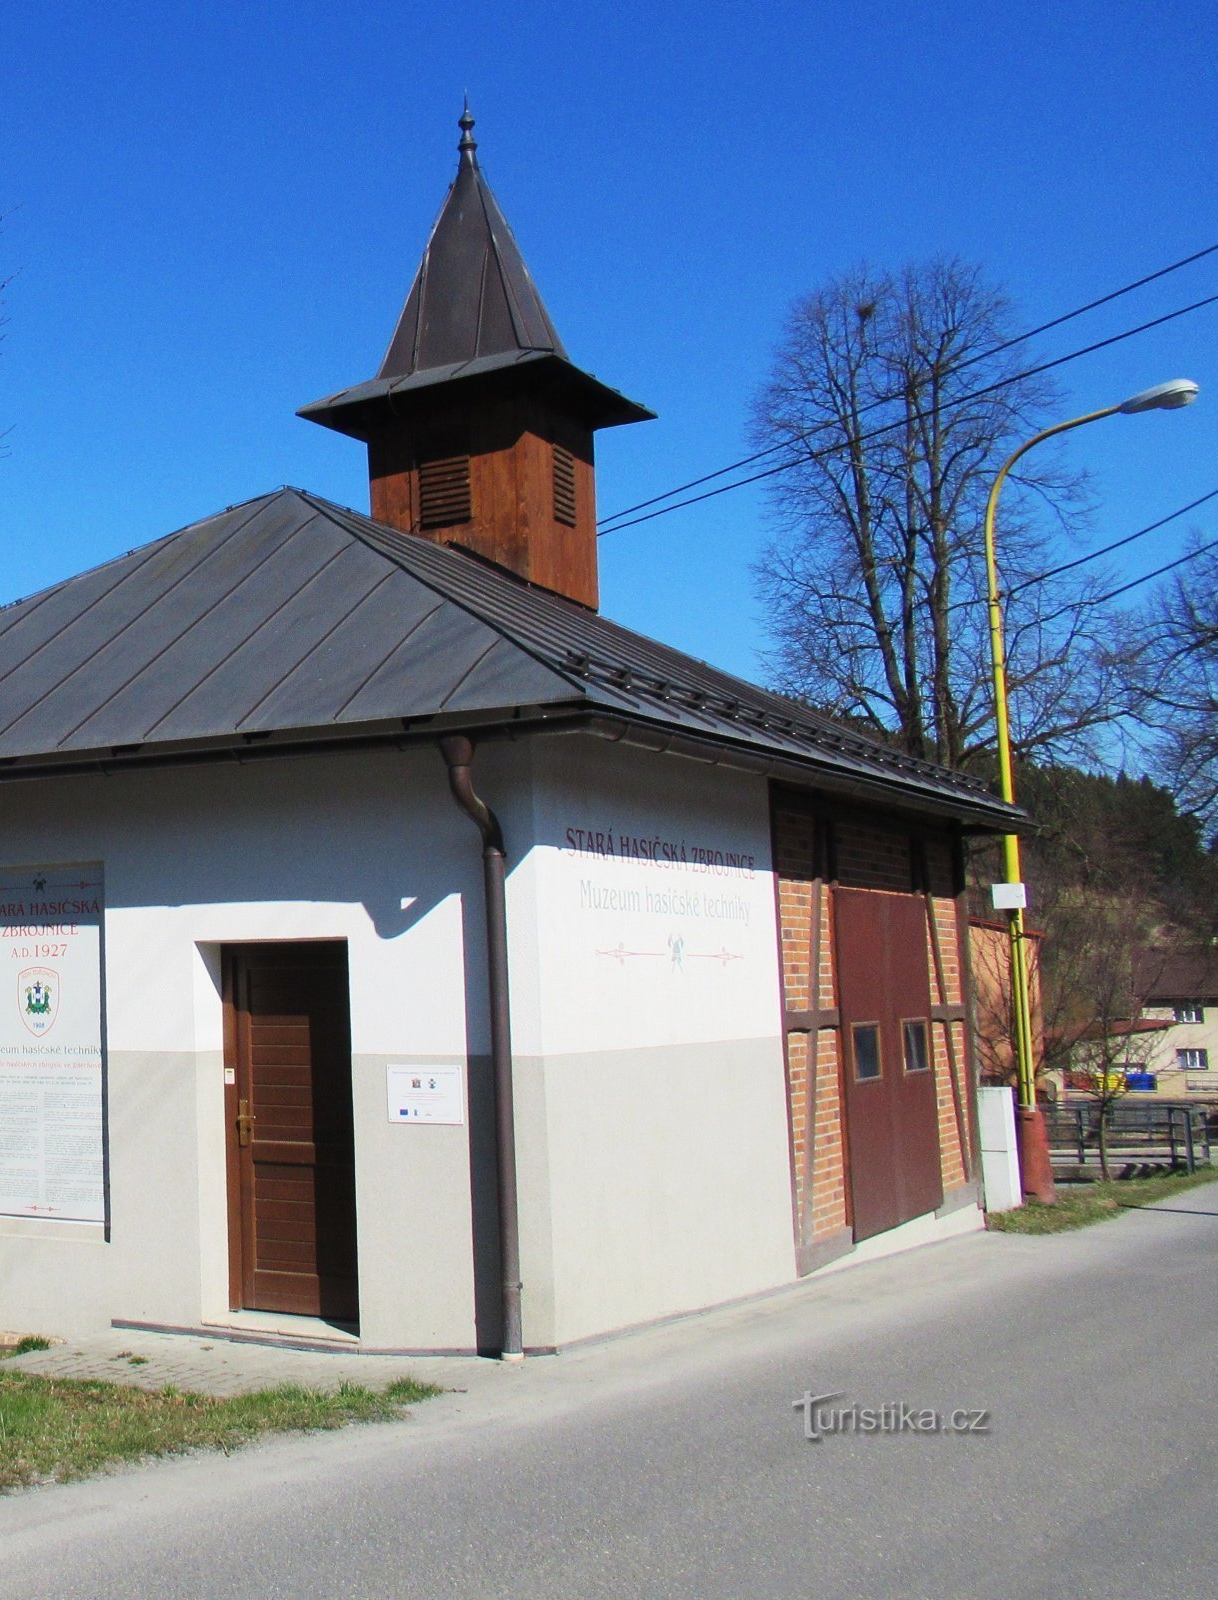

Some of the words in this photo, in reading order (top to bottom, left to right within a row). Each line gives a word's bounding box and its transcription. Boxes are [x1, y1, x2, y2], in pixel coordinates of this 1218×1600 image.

[566, 828, 614, 861] STARÁ
[620, 836, 687, 871] HASIČSKÁ
[692, 847, 755, 880] ZBROJNICE
[30, 896, 100, 916] HASIČSKÁ
[580, 879, 641, 912] Muzeum
[645, 886, 700, 917] hasičské
[703, 893, 751, 926] techniky
[2, 922, 79, 938] ZBROJNICE
[11, 947, 32, 958] A.D.
[34, 944, 68, 958] 1927
[22, 1045, 61, 1055] hasičské
